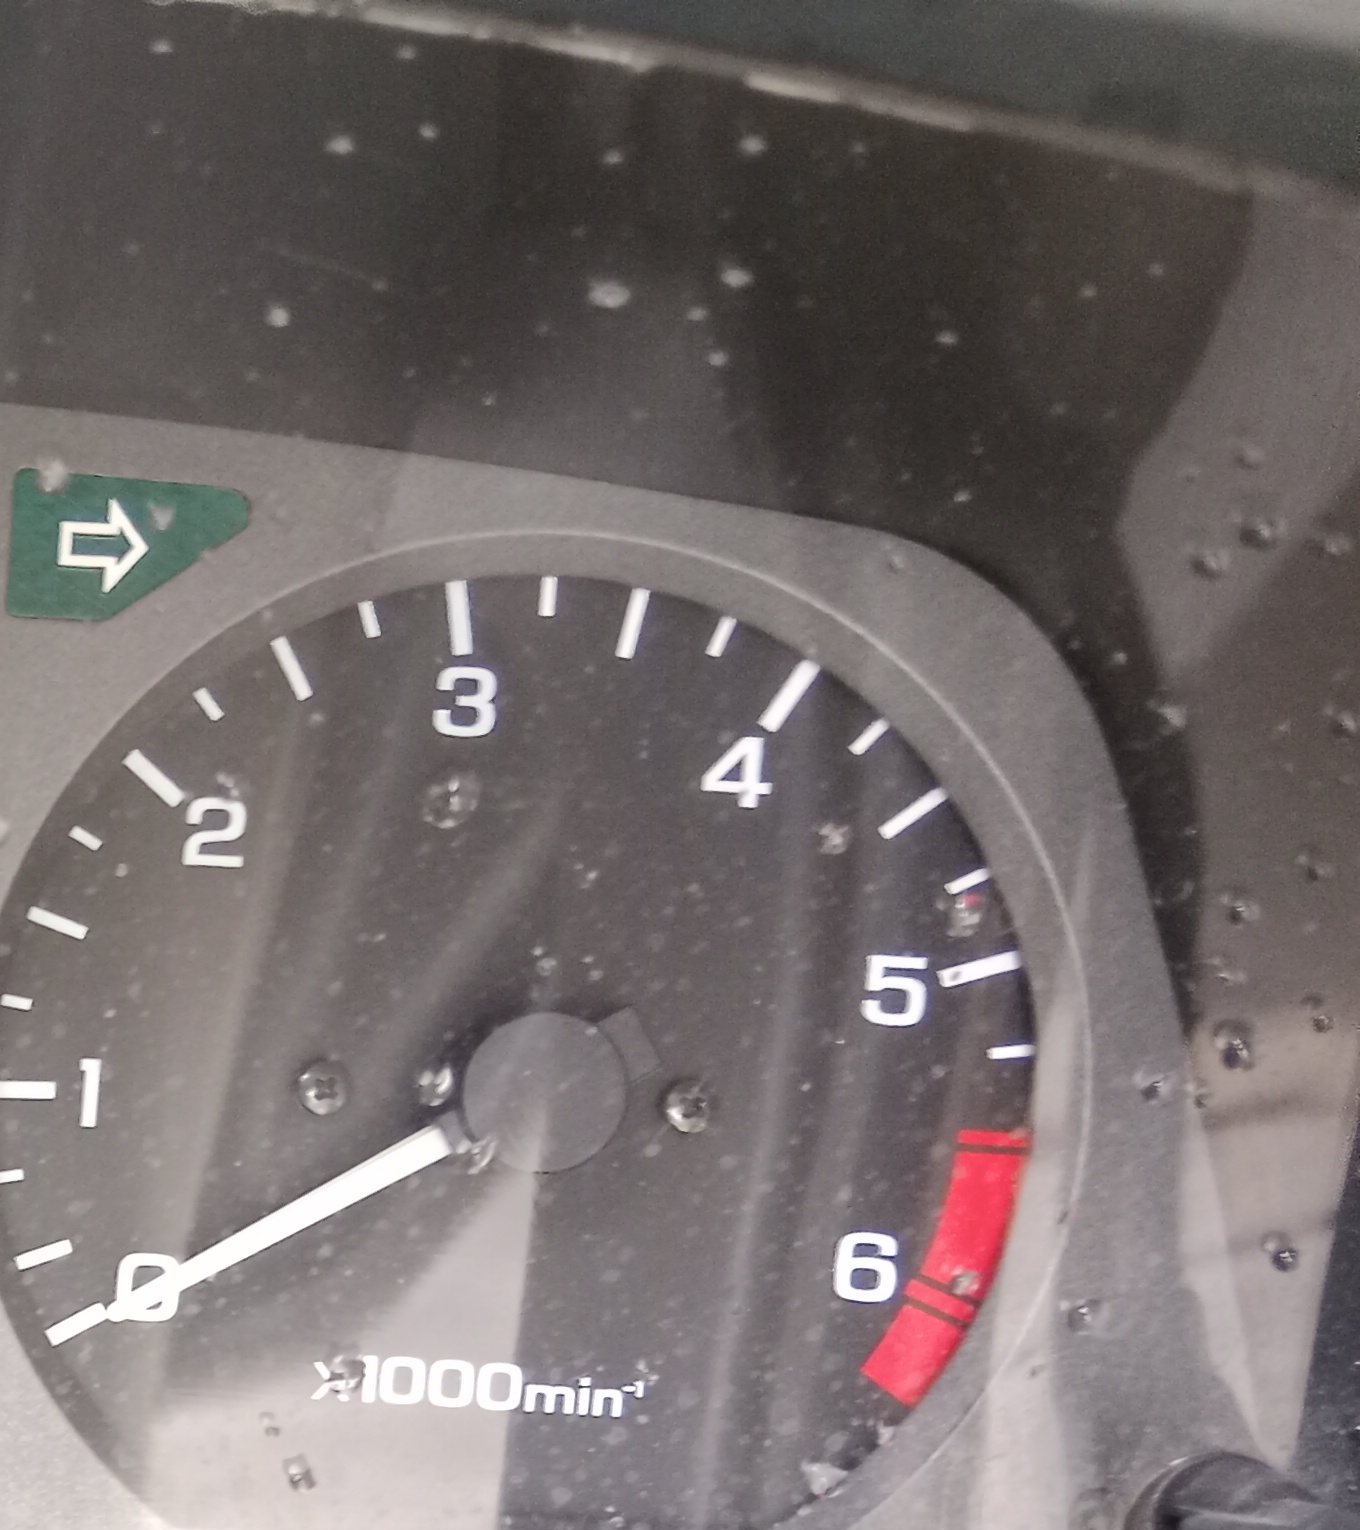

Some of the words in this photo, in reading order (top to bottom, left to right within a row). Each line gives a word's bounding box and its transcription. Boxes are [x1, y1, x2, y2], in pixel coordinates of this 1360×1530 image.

[432, 666, 497, 738] 3
[700, 736, 772, 808] 4
[182, 796, 244, 867] 2
[860, 954, 928, 1027] 5
[79, 1058, 102, 1128] 1
[116, 1252, 180, 1322] 0
[832, 1231, 897, 1303] 6
